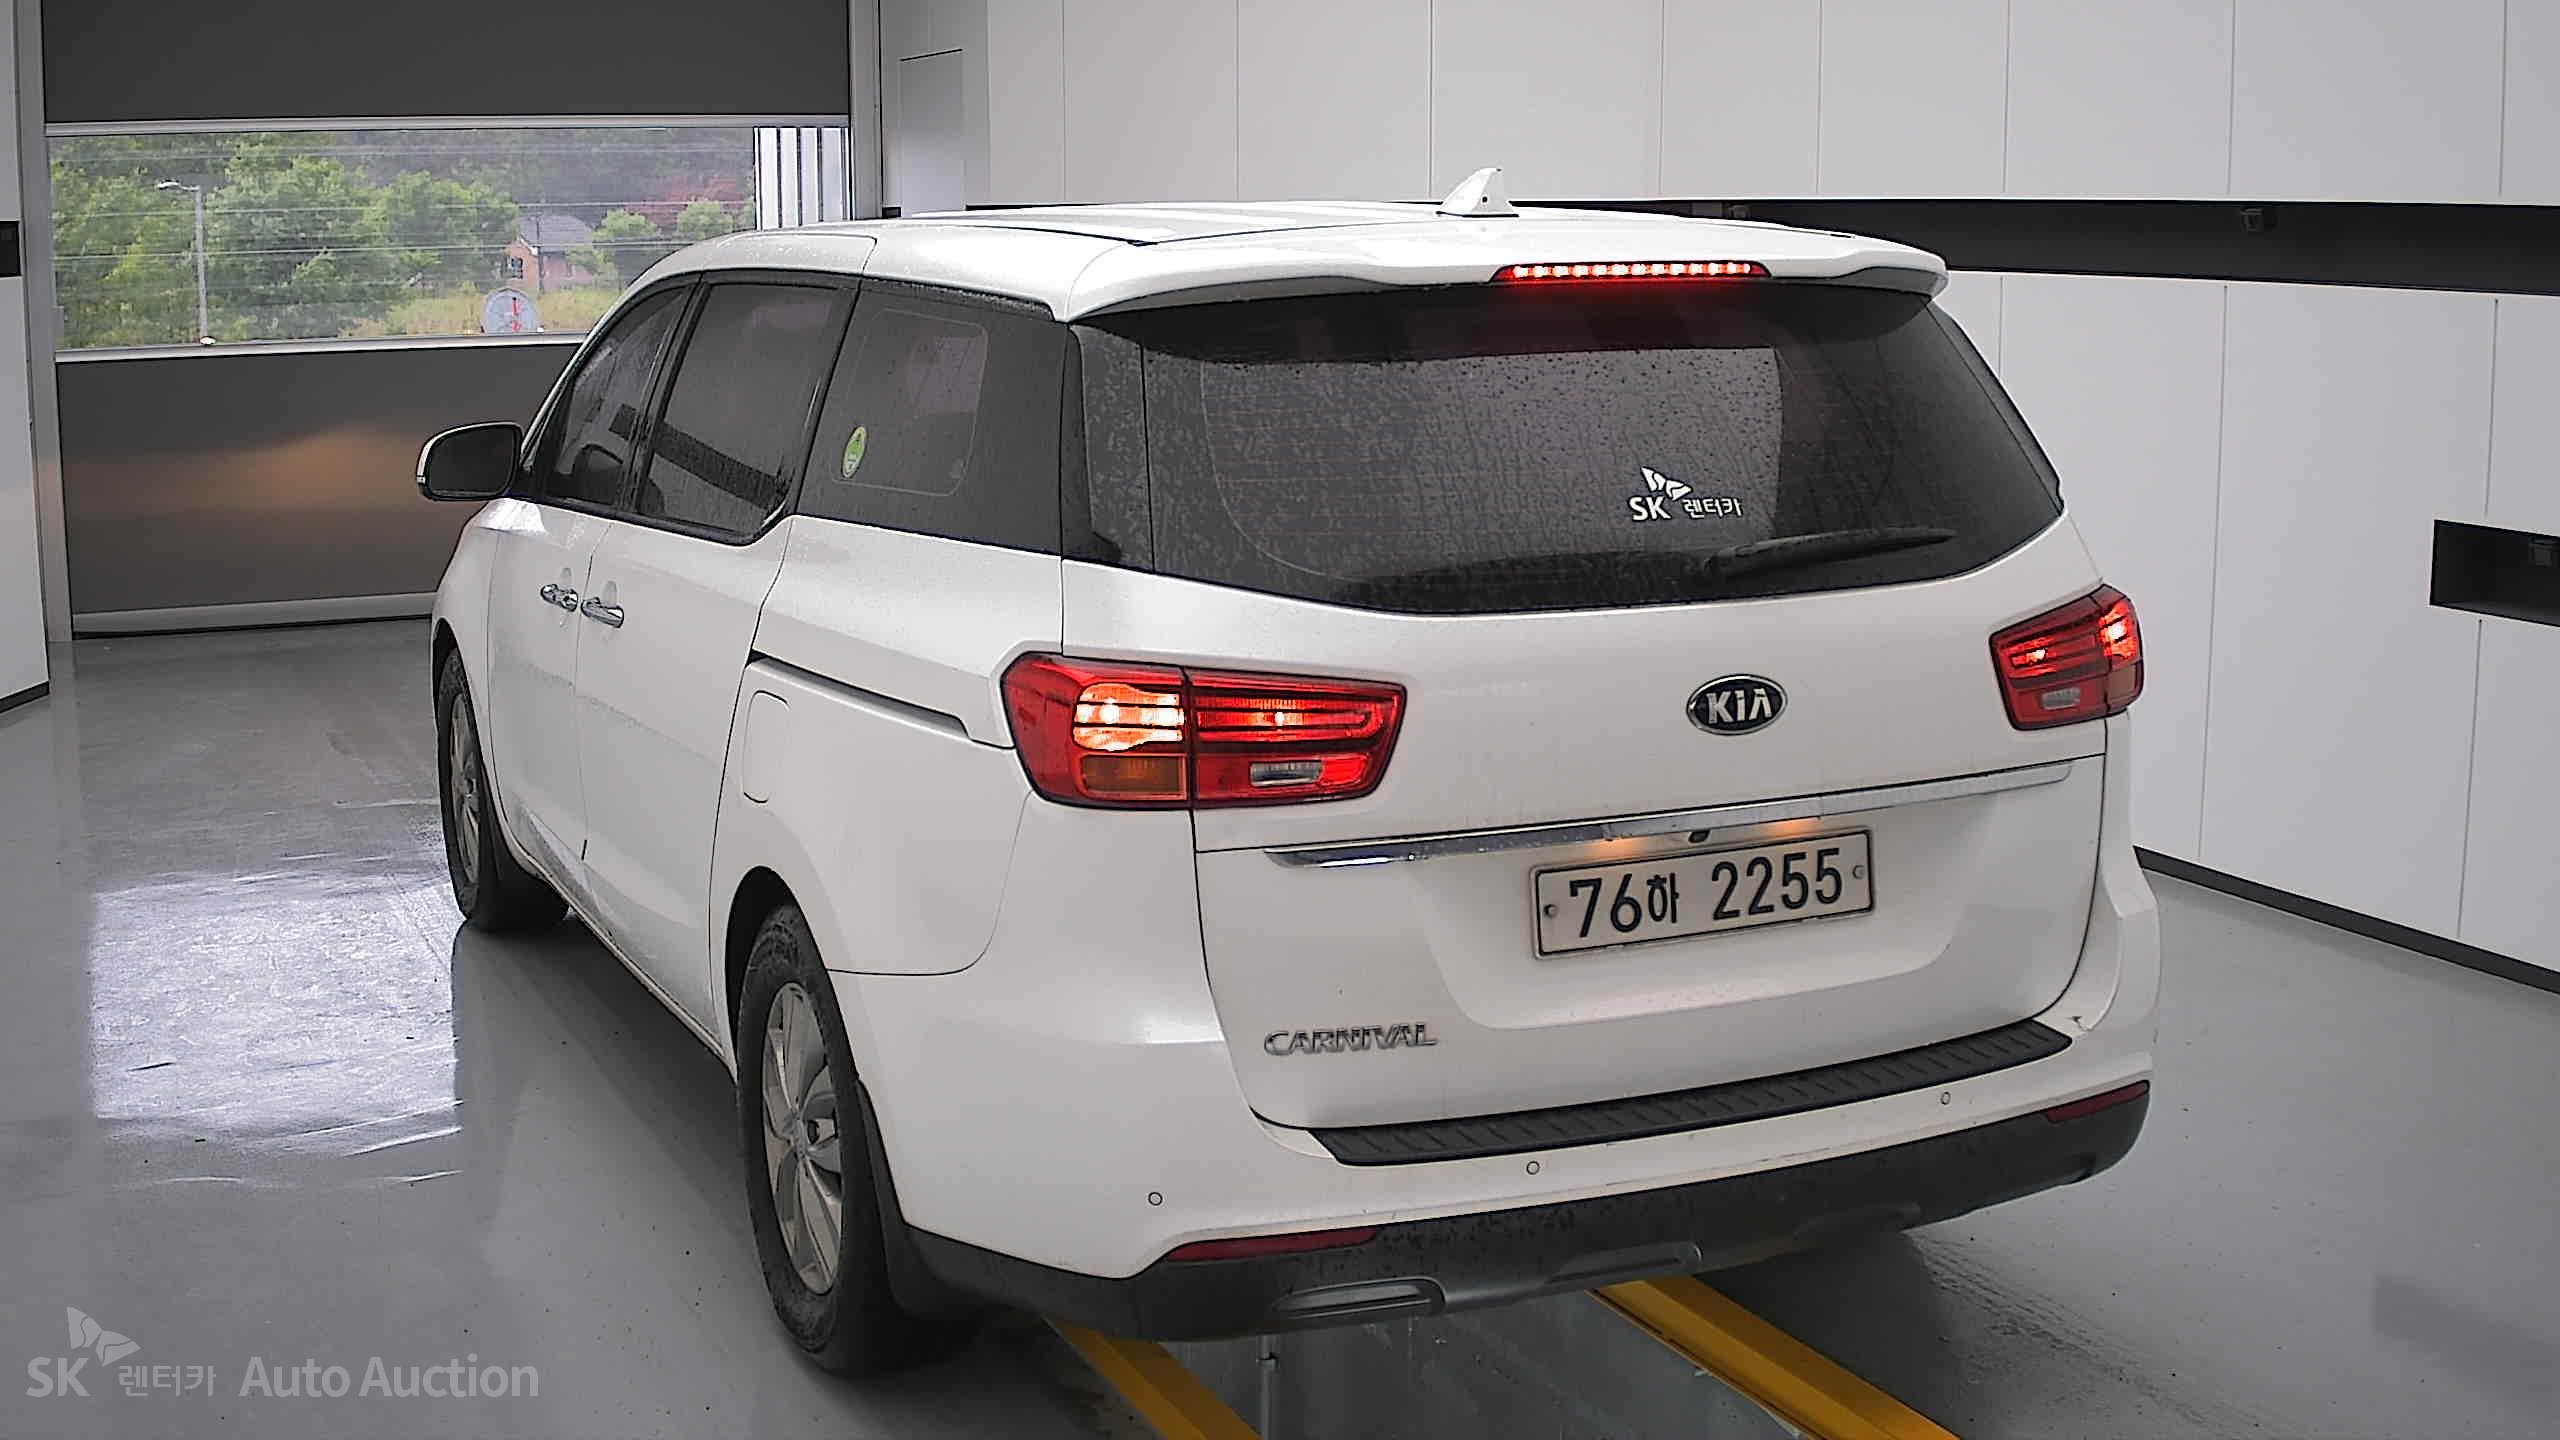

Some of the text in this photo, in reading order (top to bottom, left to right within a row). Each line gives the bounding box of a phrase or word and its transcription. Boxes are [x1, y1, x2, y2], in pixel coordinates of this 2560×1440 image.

[1629, 496, 1743, 521] SK 렌터카
[1706, 688, 1772, 724] KIA
[1569, 847, 1842, 938] 76하 2255
[1264, 1023, 1438, 1056] CARNIVAL
